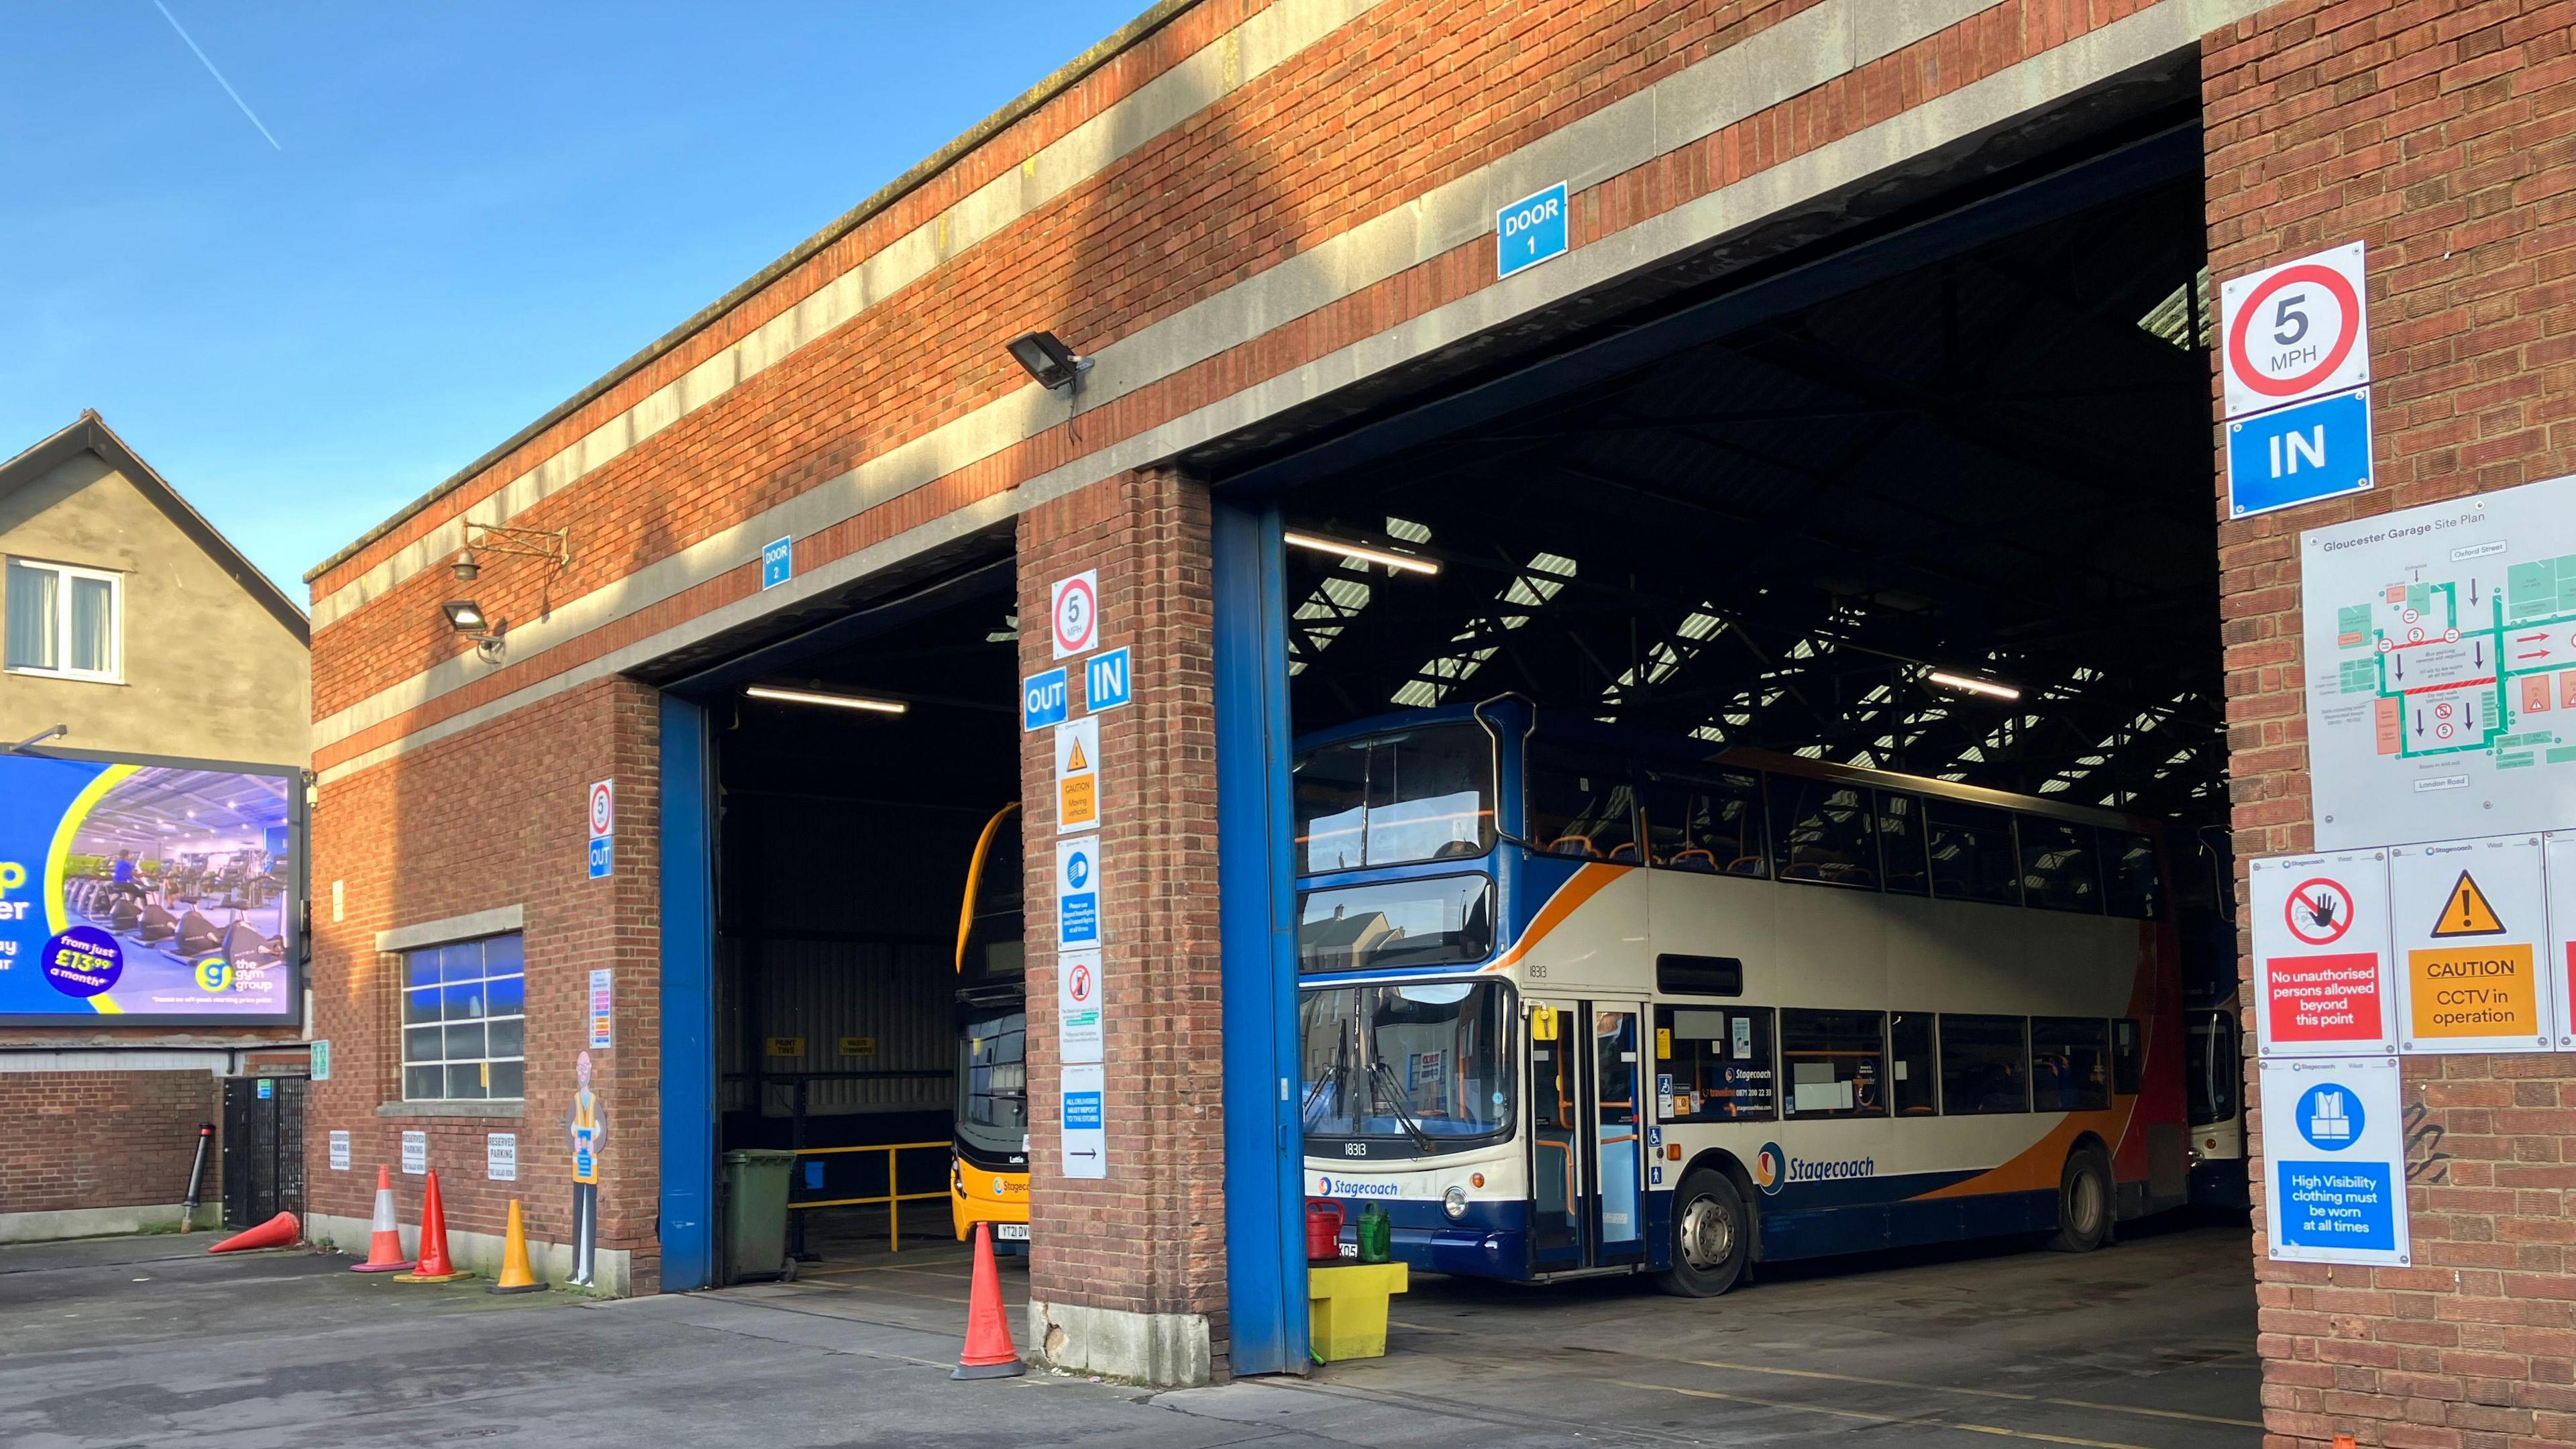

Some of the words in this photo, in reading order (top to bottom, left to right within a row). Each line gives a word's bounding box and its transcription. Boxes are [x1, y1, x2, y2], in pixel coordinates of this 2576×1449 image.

[1505, 198, 1559, 237] DOOR
[1527, 235, 1535, 255] 1
[2273, 294, 2309, 345] 5
[2271, 345, 2317, 372] MPH
[2269, 424, 2325, 479] IN
[2323, 533, 2385, 552] Gloucester
[2388, 524, 2432, 539] Garage
[2434, 518, 2457, 530] Site
[2460, 513, 2485, 525] Plan
[765, 545, 788, 565] DOOR
[2454, 548, 2479, 558] Oxford
[2481, 544, 2503, 553] Street
[773, 566, 779, 580] 2
[1067, 595, 1080, 623] 5
[1067, 625, 1082, 637] MPH
[2412, 630, 2419, 638] 5
[1093, 657, 1122, 703] IN
[1026, 682, 1064, 713] OUT
[2441, 726, 2448, 734] 5
[1065, 782, 1090, 794] CAUTION
[2418, 780, 2446, 788] London
[2447, 777, 2465, 785] Road
[597, 796, 604, 815] 5
[1068, 798, 1087, 807] Moving
[2434, 845, 2473, 853] Stagecoach
[590, 847, 610, 867] OUT
[2291, 858, 2325, 867] Stagecoach
[60, 935, 89, 951] from
[89, 943, 116, 958] just
[235, 959, 257, 969] the
[2426, 959, 2515, 978] CAUTION
[50, 967, 59, 976] a
[235, 970, 265, 981] gym
[1529, 965, 1547, 978] 18313
[2271, 971, 2290, 983] No
[2292, 966, 2375, 983] unauthorised
[235, 980, 273, 993] group
[2273, 986, 2322, 1000] persons
[2324, 981, 2375, 996] allowed
[2436, 989, 2489, 1006] CCTV
[2493, 988, 2509, 1004] in
[2300, 997, 2348, 1013] beyond
[2296, 1013, 2318, 1026] this
[2320, 1012, 2354, 1027] point
[2432, 1010, 2515, 1030] operation
[2301, 1063, 2335, 1071] Stagecoach
[1735, 1069, 1771, 1081] Stagecoach
[1735, 1089, 1748, 1097] 0871
[1748, 1089, 1758, 1097] 200
[402, 1134, 425, 1143] RESERVED
[488, 1137, 515, 1146] RESERVED
[404, 1145, 423, 1154] PARKING
[490, 1149, 513, 1159] PARKING
[1345, 1142, 1366, 1156] 18313
[1009, 1155, 1024, 1164] Lottie
[1788, 1156, 1874, 1181] Stagecoach
[1334, 1180, 1398, 1197] Stagecoach
[2292, 1175, 2321, 1189] High
[2323, 1175, 2377, 1191] Visibility
[2292, 1190, 2343, 1205] clothing
[2345, 1192, 2377, 1203] must
[2309, 1205, 2326, 1217] be
[2328, 1208, 2361, 1218] worn
[1002, 1226, 1017, 1238] YT21
[2303, 1219, 2316, 1231] at
[2318, 1220, 2332, 1231] all
[2334, 1220, 2369, 1233] times
